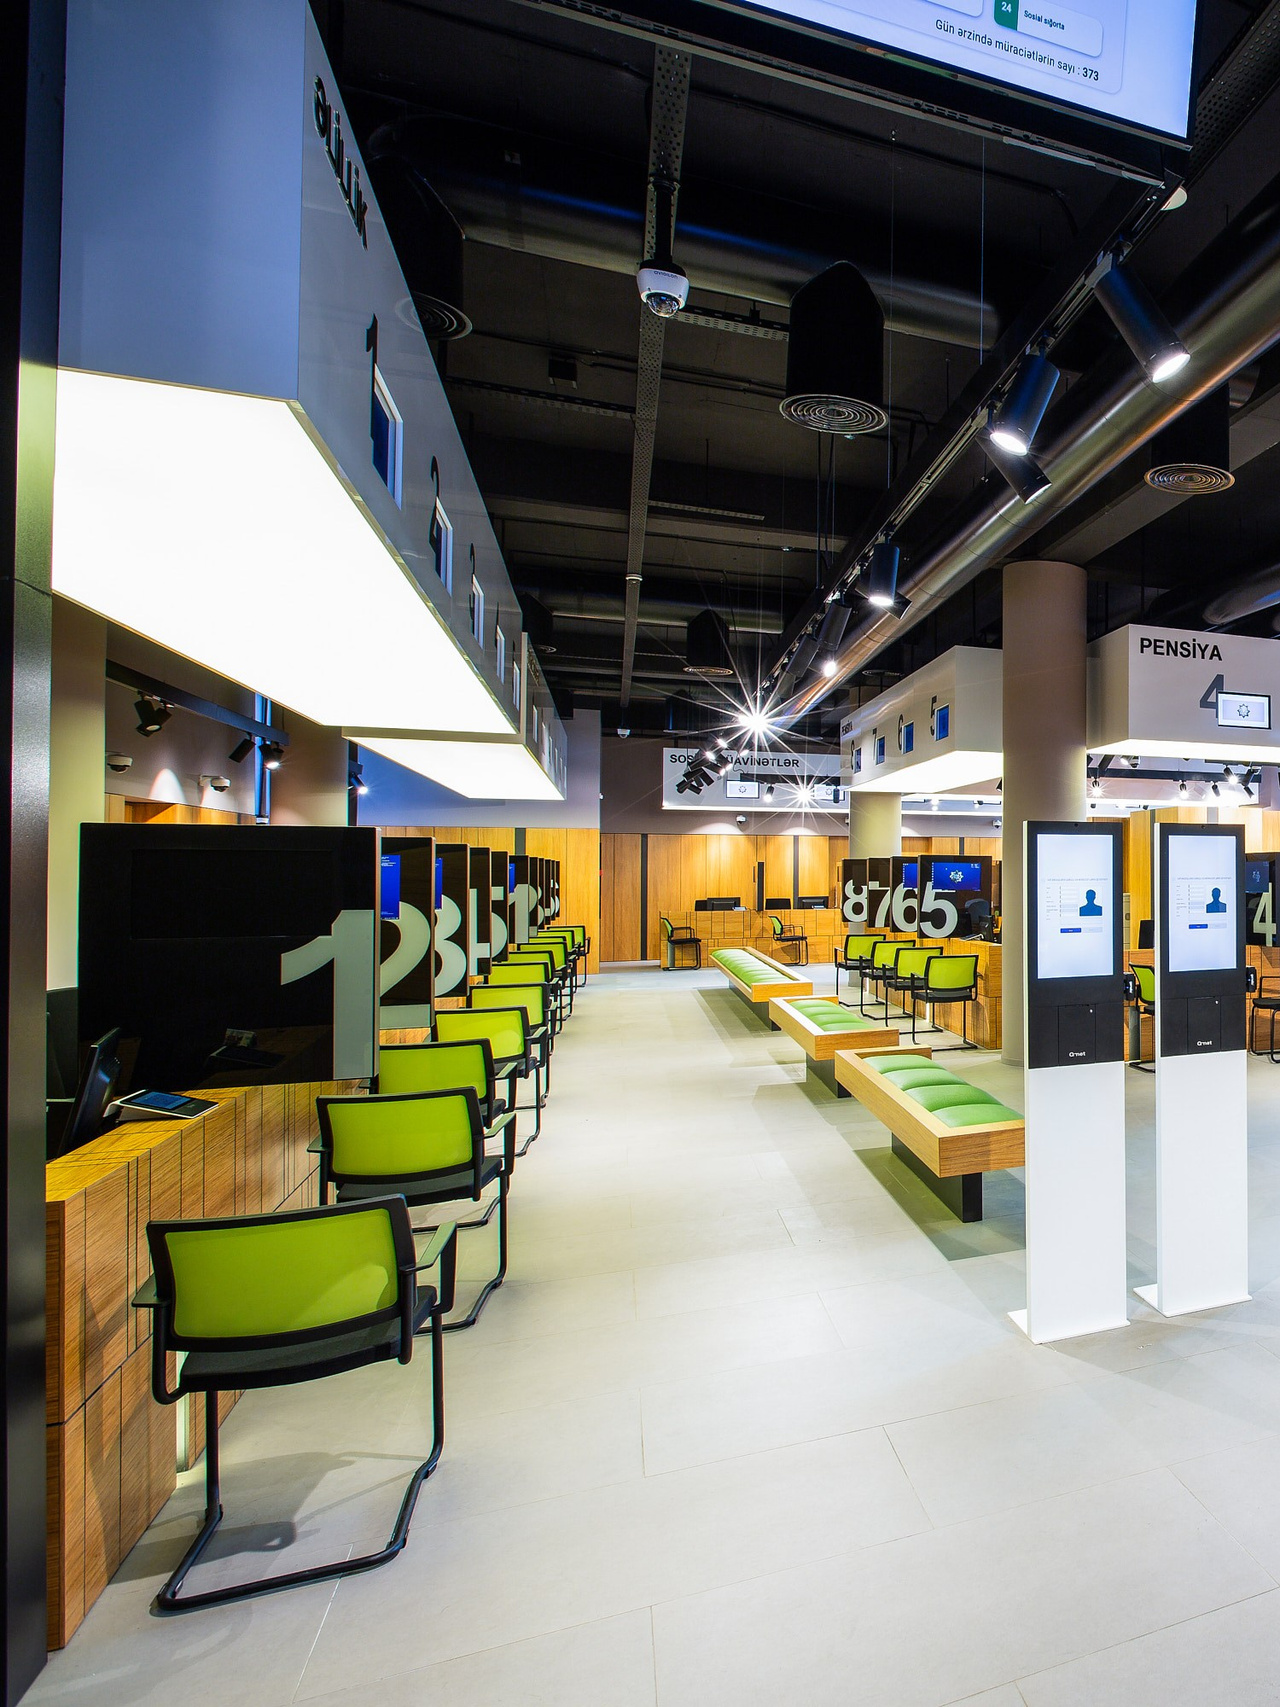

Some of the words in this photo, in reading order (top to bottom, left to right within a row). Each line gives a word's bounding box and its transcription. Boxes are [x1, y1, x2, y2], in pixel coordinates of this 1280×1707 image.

[1001, 2, 1012, 13] 24
[1023, 10, 1043, 23] Sosial
[935, 19, 955, 34] Gün
[958, 28, 993, 46] ərzində
[995, 39, 1055, 67] müraciətlərin
[1057, 60, 1076, 75] sayı
[1082, 67, 1099, 81] 373
[1139, 637, 1222, 661] PENSİYA
[1200, 674, 1224, 719] 4
[727, 755, 800, 768] ÜAVİNƏTLƏR
[843, 879, 867, 923] 8
[869, 881, 890, 928] 7
[892, 882, 918, 932] 6
[919, 881, 958, 938] 5
[1253, 882, 1277, 947] 4
[280, 910, 374, 1080] 1
